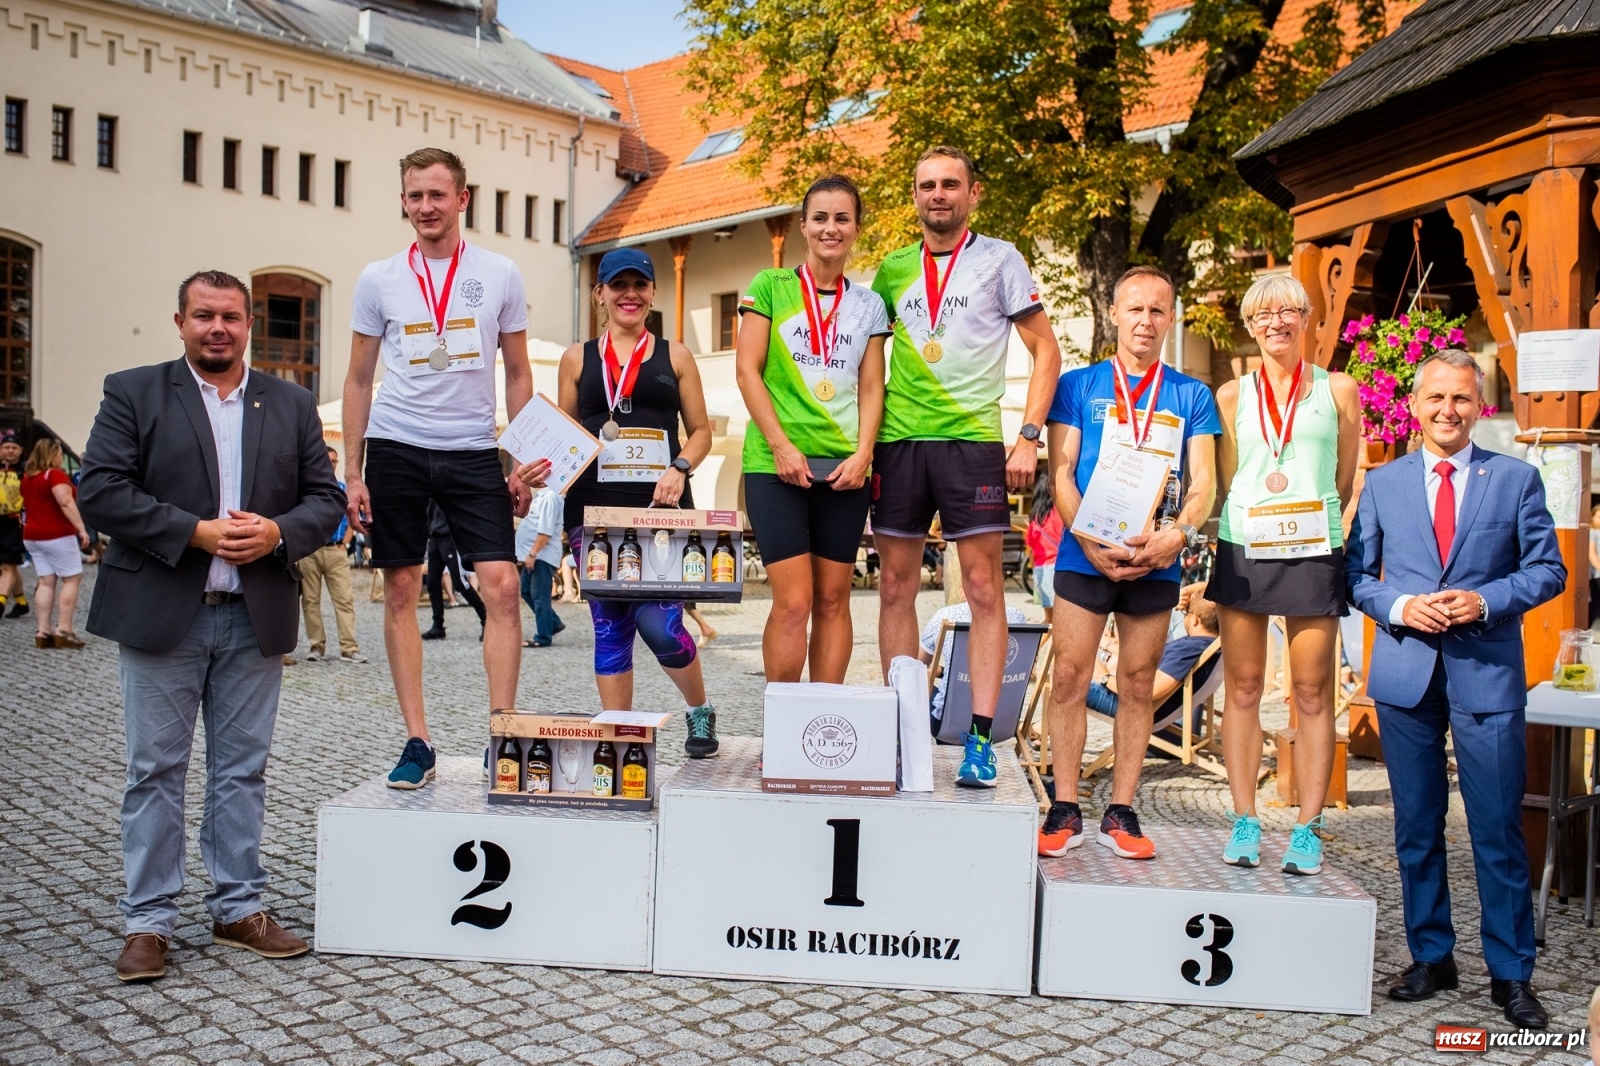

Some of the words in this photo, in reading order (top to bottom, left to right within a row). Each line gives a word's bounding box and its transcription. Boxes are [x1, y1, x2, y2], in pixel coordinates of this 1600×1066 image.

[904, 296, 968, 312] AKWNI
[532, 426, 548, 446] DYPLOM
[626, 445, 644, 460] 32
[1116, 476, 1139, 490] DYPLOM
[632, 517, 696, 526] RACIBORSKIE
[1278, 520, 1298, 536] 19
[539, 726, 604, 738] RACIBORSKIE
[832, 738, 853, 751] 1567
[824, 818, 865, 908] 1
[451, 840, 512, 930] 2
[726, 926, 798, 951] OSIR
[807, 930, 960, 960] RACIBÓRZ
[1180, 913, 1234, 986] 3
